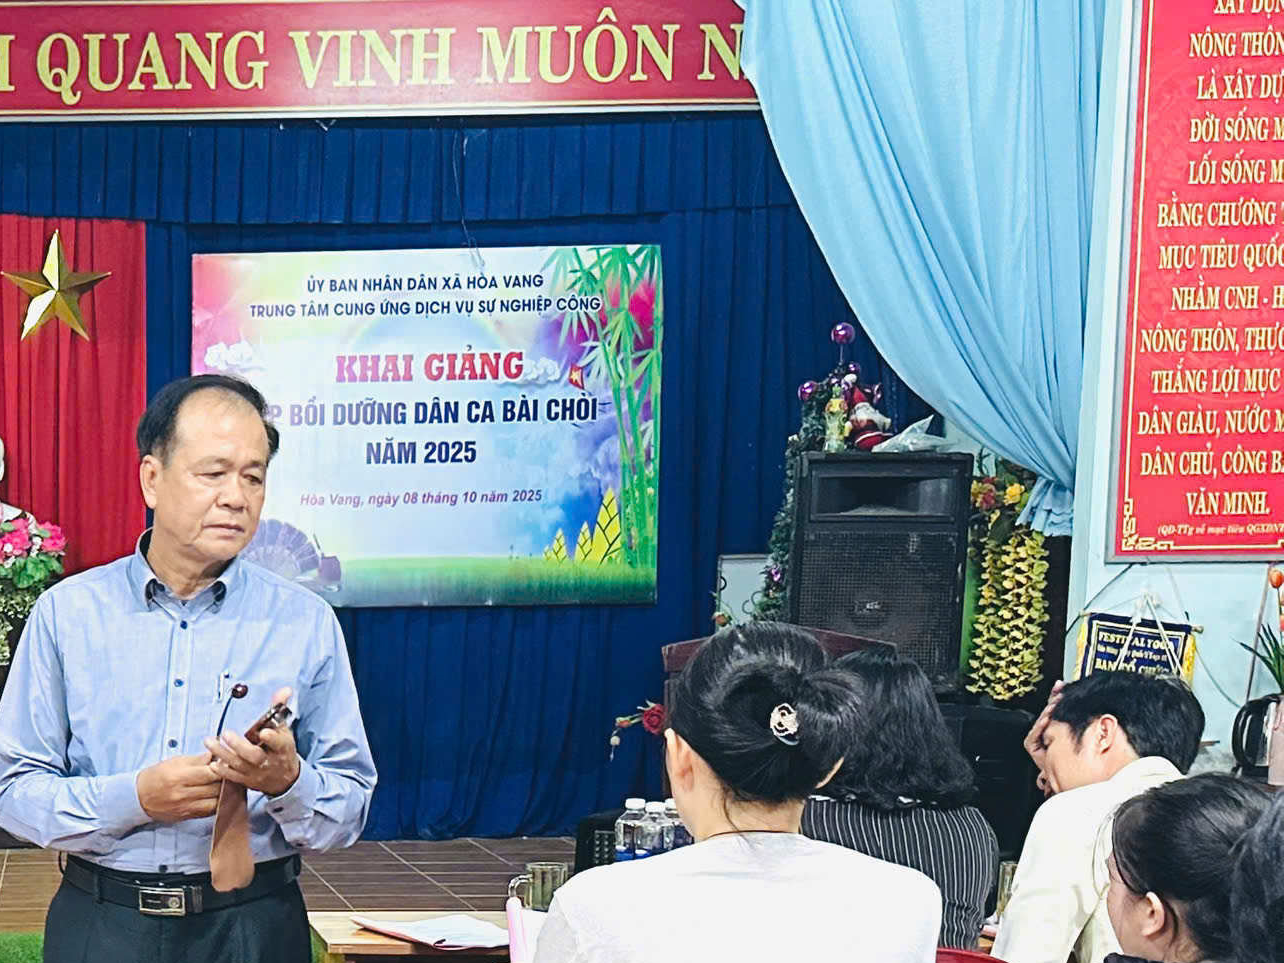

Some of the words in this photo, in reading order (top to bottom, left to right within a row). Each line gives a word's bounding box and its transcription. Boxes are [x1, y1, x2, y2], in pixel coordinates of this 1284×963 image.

[35, 30, 269, 106] QUANG
[289, 28, 454, 89] VINH
[477, 7, 681, 86] MUÔN
[1189, 26, 1237, 58] NÔNG
[1241, 24, 1284, 57] THÔN
[1196, 68, 1219, 100] LÀ
[1222, 68, 1257, 100] XÂY
[1189, 111, 1220, 143] ĐỜI
[1224, 106, 1269, 142] SỐNG
[1188, 149, 1217, 185] LỐI
[1221, 149, 1266, 184] SỐNG
[1157, 191, 1204, 228] BẰNG
[1207, 196, 1277, 227] CHƯƠNG
[1158, 245, 1196, 275] MỤC
[1200, 237, 1240, 269] TIÊU
[307, 274, 327, 293] ỦY
[330, 277, 358, 292] BAN
[362, 274, 404, 292] NHÂN
[408, 273, 437, 291] DÂN
[442, 272, 463, 290] XÃ
[467, 273, 499, 290] HÒA
[503, 274, 544, 288] VANG
[1171, 274, 1221, 311] NHẰM
[1224, 286, 1259, 310] CNH
[250, 303, 296, 318] TRUNG
[300, 302, 330, 317] TÂM
[333, 301, 376, 316] CUNG
[380, 299, 412, 316] ỨNG
[416, 301, 451, 318] DỊCH
[455, 300, 473, 318] VỤ
[478, 299, 497, 317] SỰ
[500, 298, 552, 316] NGHIỆP
[556, 294, 601, 312] CÔNG
[1140, 322, 1187, 353] NÔNG
[1191, 321, 1240, 356] THÔN,
[335, 353, 413, 383] KHAI
[424, 344, 524, 382] GIẢNG
[1151, 358, 1208, 394] THẮNG
[1212, 365, 1240, 398] LỢI
[1243, 368, 1281, 398] MỤC
[289, 396, 325, 426] BỒI
[332, 400, 407, 426] DƯỠNG
[414, 399, 457, 425] DÂN
[466, 401, 495, 423] CA
[502, 394, 538, 422] BÀI
[544, 392, 598, 422] CHÒI
[1137, 404, 1173, 435] DÂN
[1176, 404, 1221, 438] GIÀU,
[1224, 402, 1271, 434] NƯỚC
[366, 436, 416, 465] NĂM
[424, 440, 477, 465] 2025
[1140, 445, 1176, 476] DÂN
[1179, 441, 1218, 479] CHỦ,
[1221, 444, 1267, 475] CÔNG
[300, 493, 325, 506] Hòa
[329, 493, 365, 508] Vang,
[368, 493, 398, 508] ngày
[403, 492, 418, 505] 08
[421, 491, 458, 506] tháng
[462, 491, 477, 503] 10
[480, 491, 508, 503] năm
[512, 489, 543, 502] 2025
[1186, 487, 1220, 516] VĂN
[1222, 491, 1271, 515] MINH.
